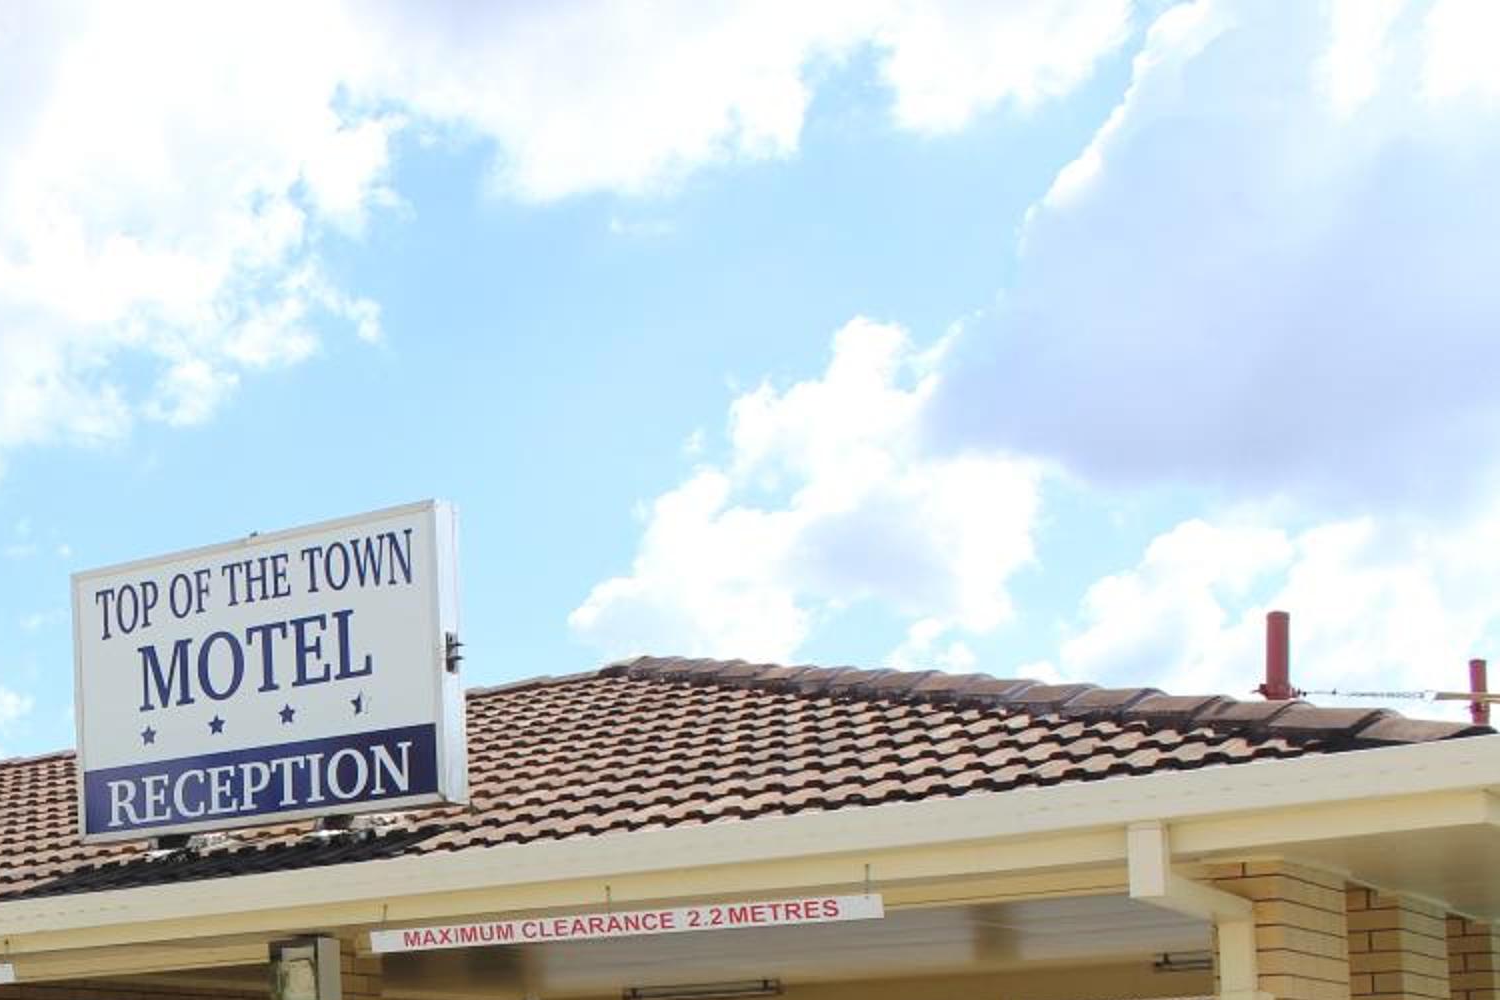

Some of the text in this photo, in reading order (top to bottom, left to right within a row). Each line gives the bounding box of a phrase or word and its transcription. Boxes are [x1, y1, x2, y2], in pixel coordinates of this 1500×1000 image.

[96, 529, 413, 640] TOP OF THE TOWN
[137, 609, 373, 712] MOTEL
[107, 741, 412, 827] RECEPTION
[403, 900, 839, 947] MAXIMUM CLEARANCE 2.2 METRES
